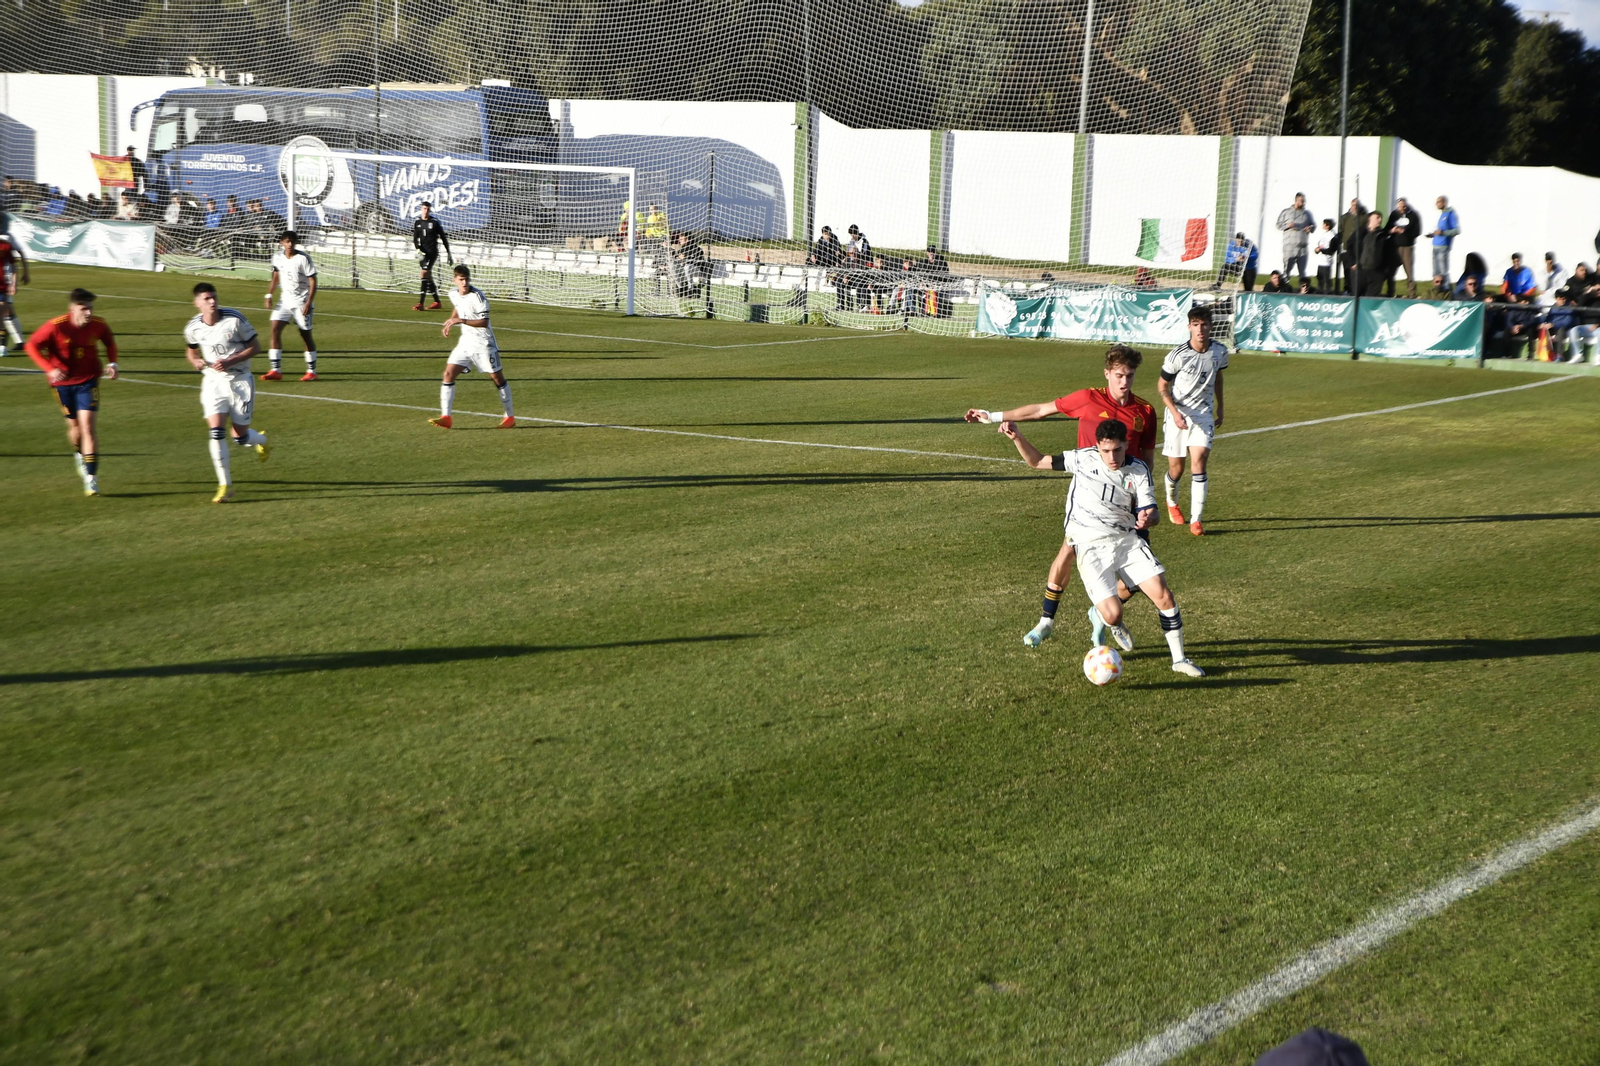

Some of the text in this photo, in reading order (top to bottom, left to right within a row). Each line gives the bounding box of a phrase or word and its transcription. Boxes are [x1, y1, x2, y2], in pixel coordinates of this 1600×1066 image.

[201, 153, 246, 163] JUVENTUD
[181, 160, 248, 172] TORREMOLINOS
[399, 179, 480, 220] VERDES!
[1297, 301, 1320, 311] PACO
[1132, 316, 1144, 325] 13
[1297, 315, 1318, 323] DANZA
[211, 343, 227, 356] 10
[1198, 371, 1208, 385] 3
[1101, 482, 1116, 503] 11
